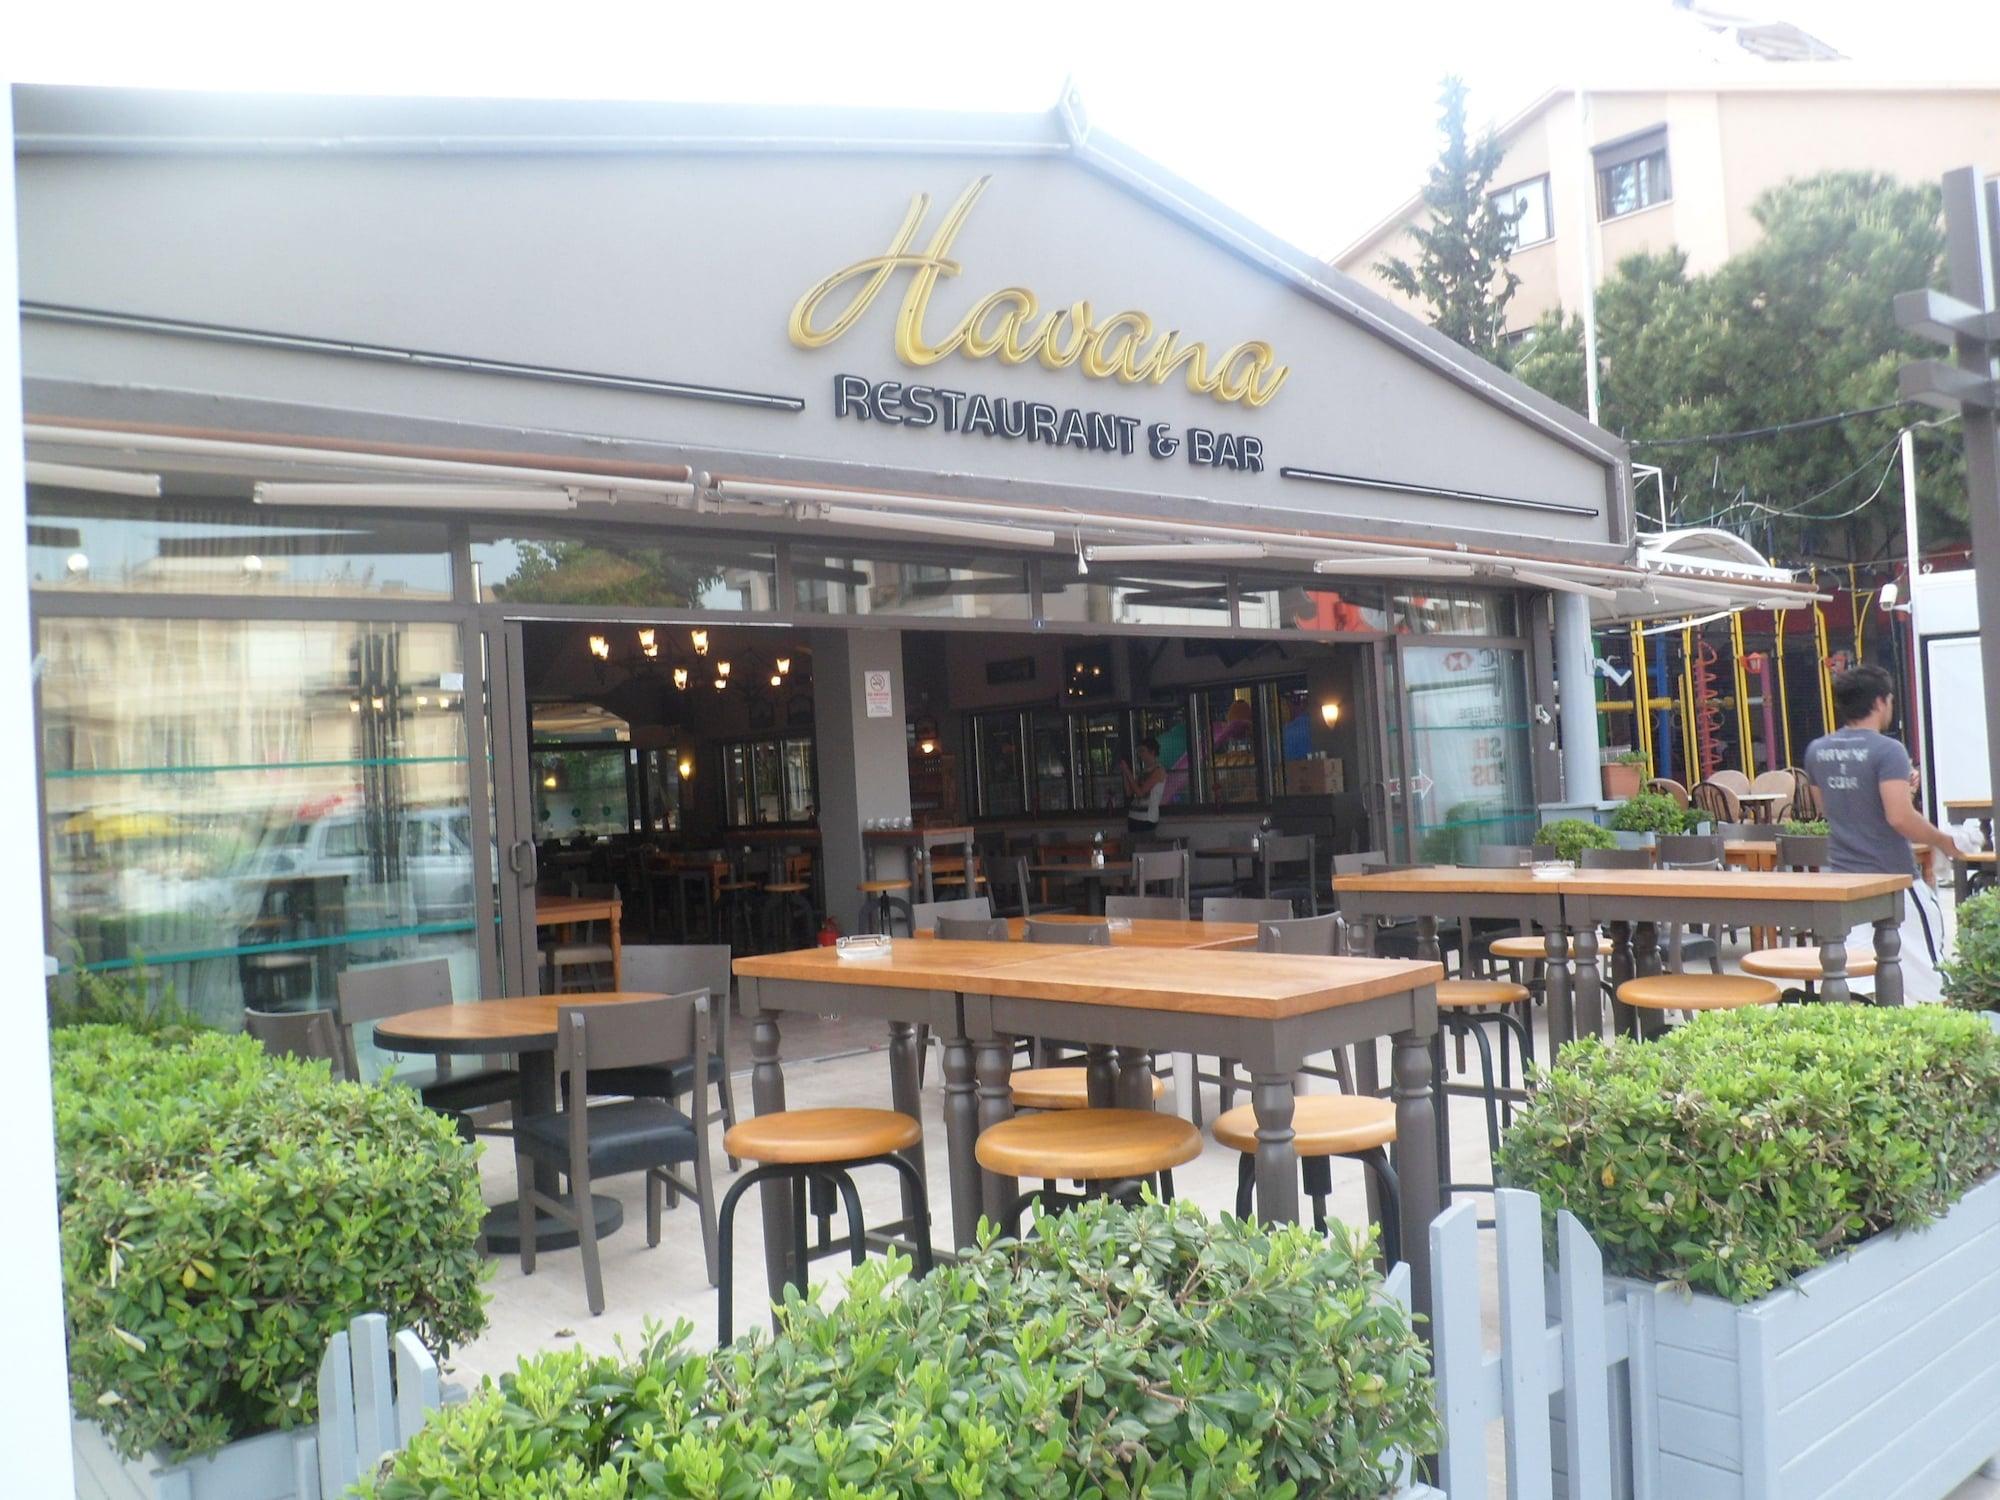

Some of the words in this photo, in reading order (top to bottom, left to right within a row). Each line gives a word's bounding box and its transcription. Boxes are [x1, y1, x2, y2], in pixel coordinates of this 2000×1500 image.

[788, 174, 1291, 409] Havana
[834, 373, 1140, 455] RESTAURANT
[1148, 422, 1180, 460] &
[1187, 427, 1265, 472] BAR
